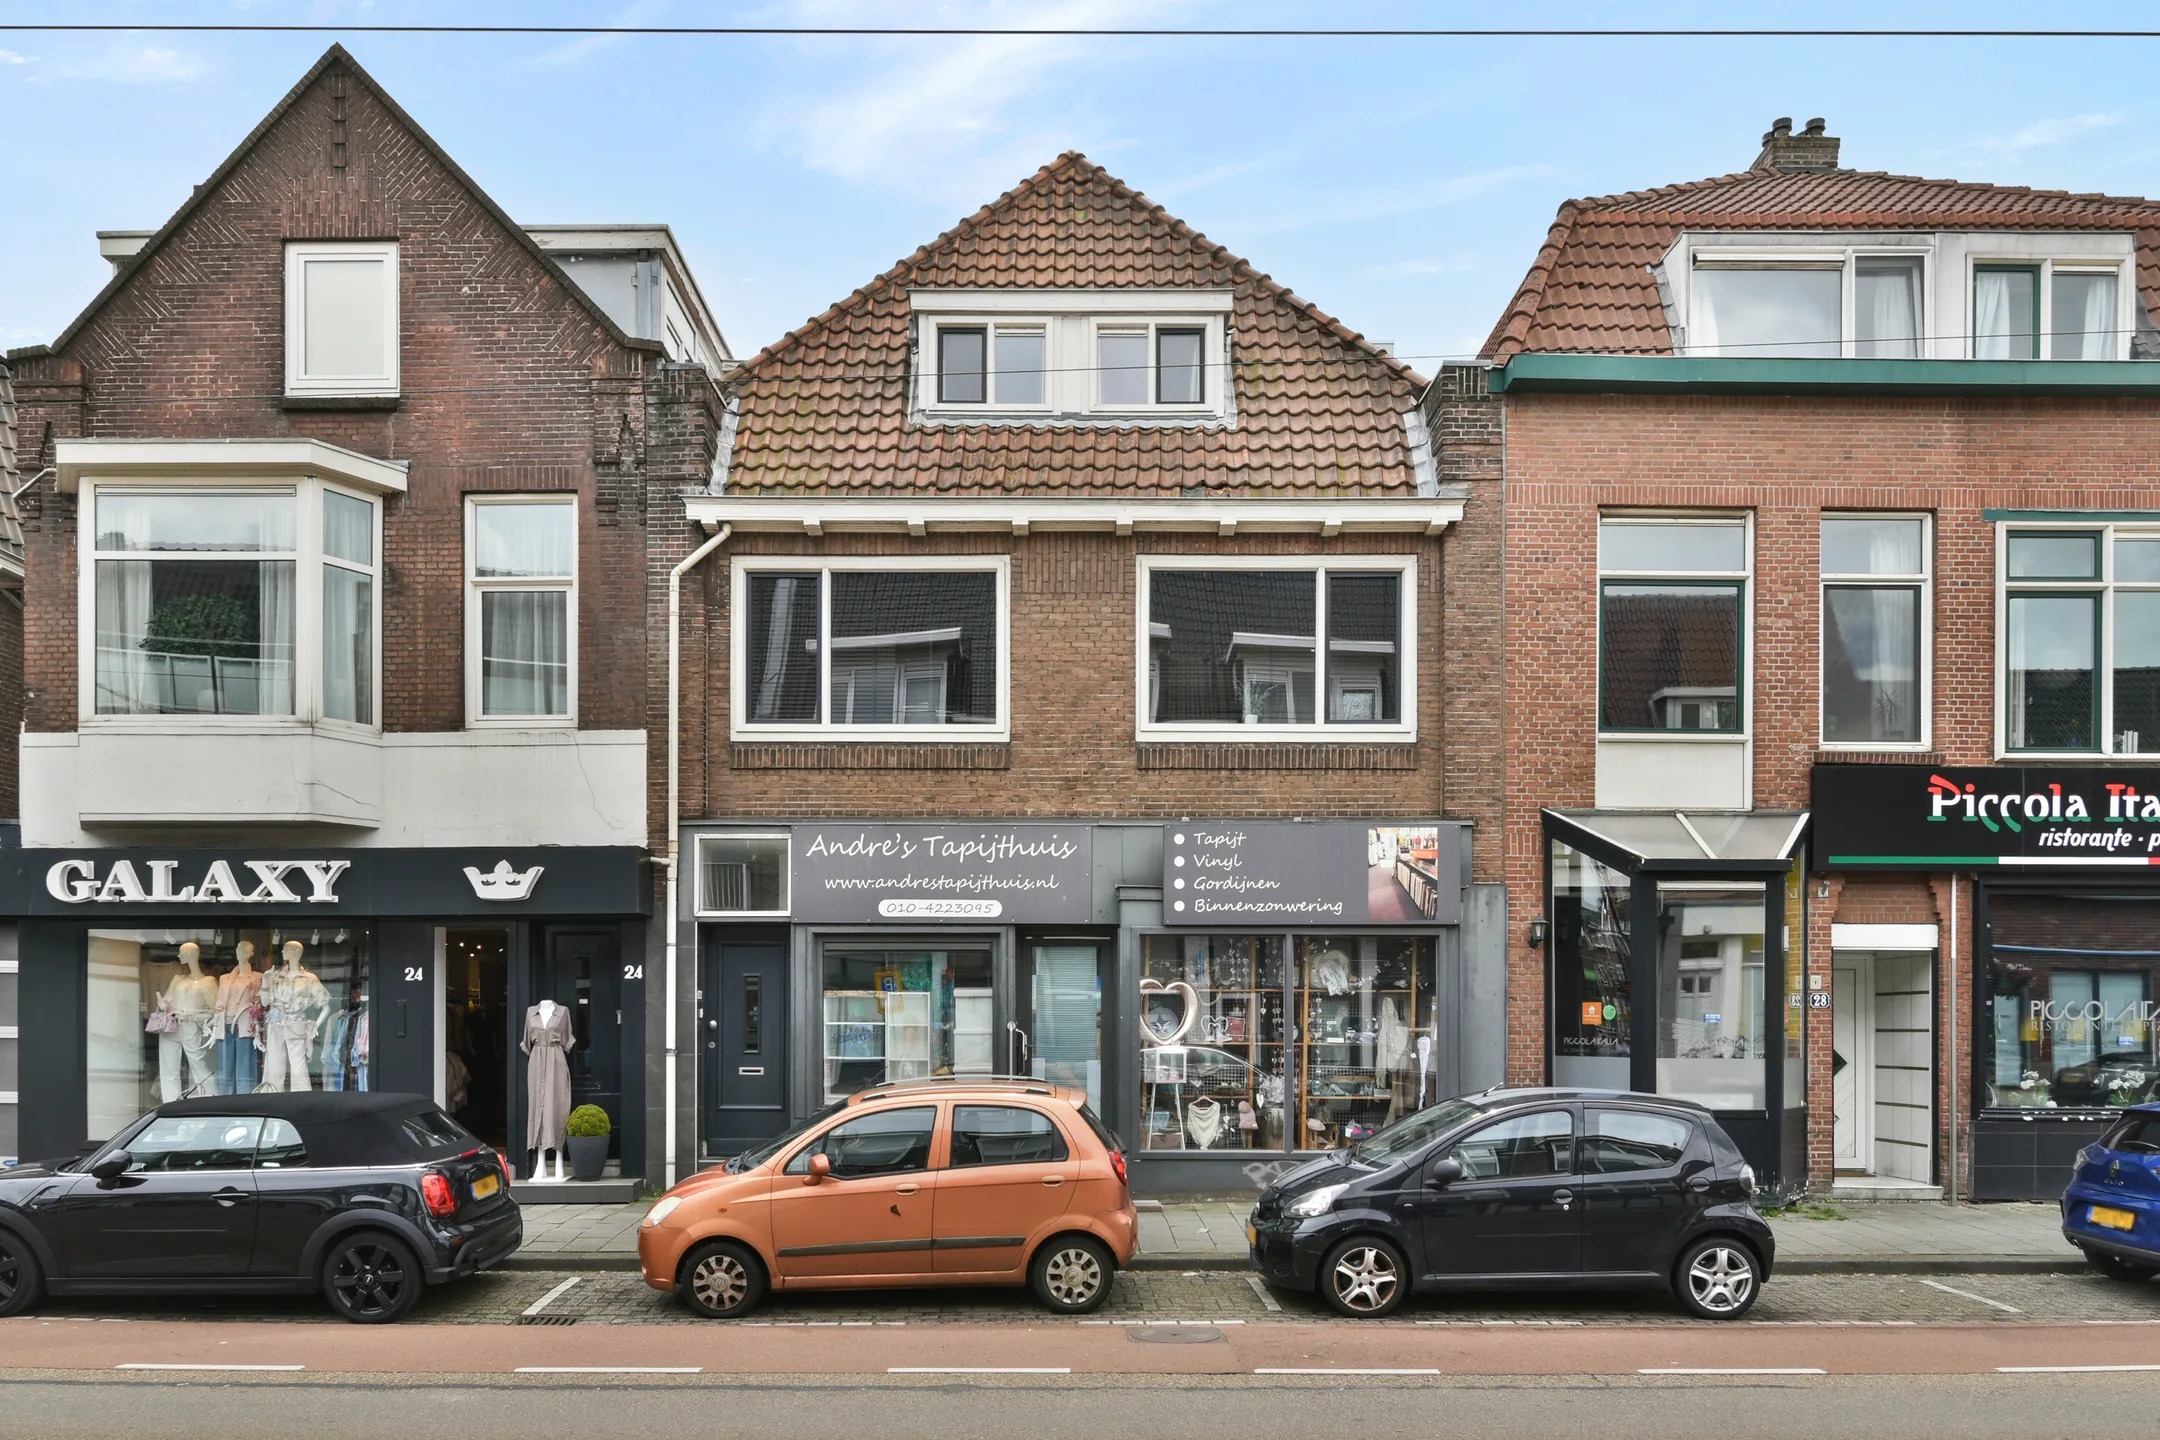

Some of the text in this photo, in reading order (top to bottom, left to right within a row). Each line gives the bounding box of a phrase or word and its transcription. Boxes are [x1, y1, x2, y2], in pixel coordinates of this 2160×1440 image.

[1927, 774, 2092, 833] Piccola
[806, 833, 1078, 863] Andre's Tapijthuis
[1193, 831, 1247, 849] Tapijt
[2038, 828, 2133, 851] ristorante
[1193, 853, 1243, 871] Vinyl
[46, 859, 351, 903] GALAXY
[824, 873, 1060, 893] www.andrestapijthuis.nl
[1193, 875, 1281, 893] Gordijnen
[886, 902, 994, 914] 010-4223095
[1194, 898, 1343, 915] Binnenzonwering
[404, 967, 423, 981] 24
[624, 965, 643, 979] 24
[1813, 994, 1827, 1007] 28
